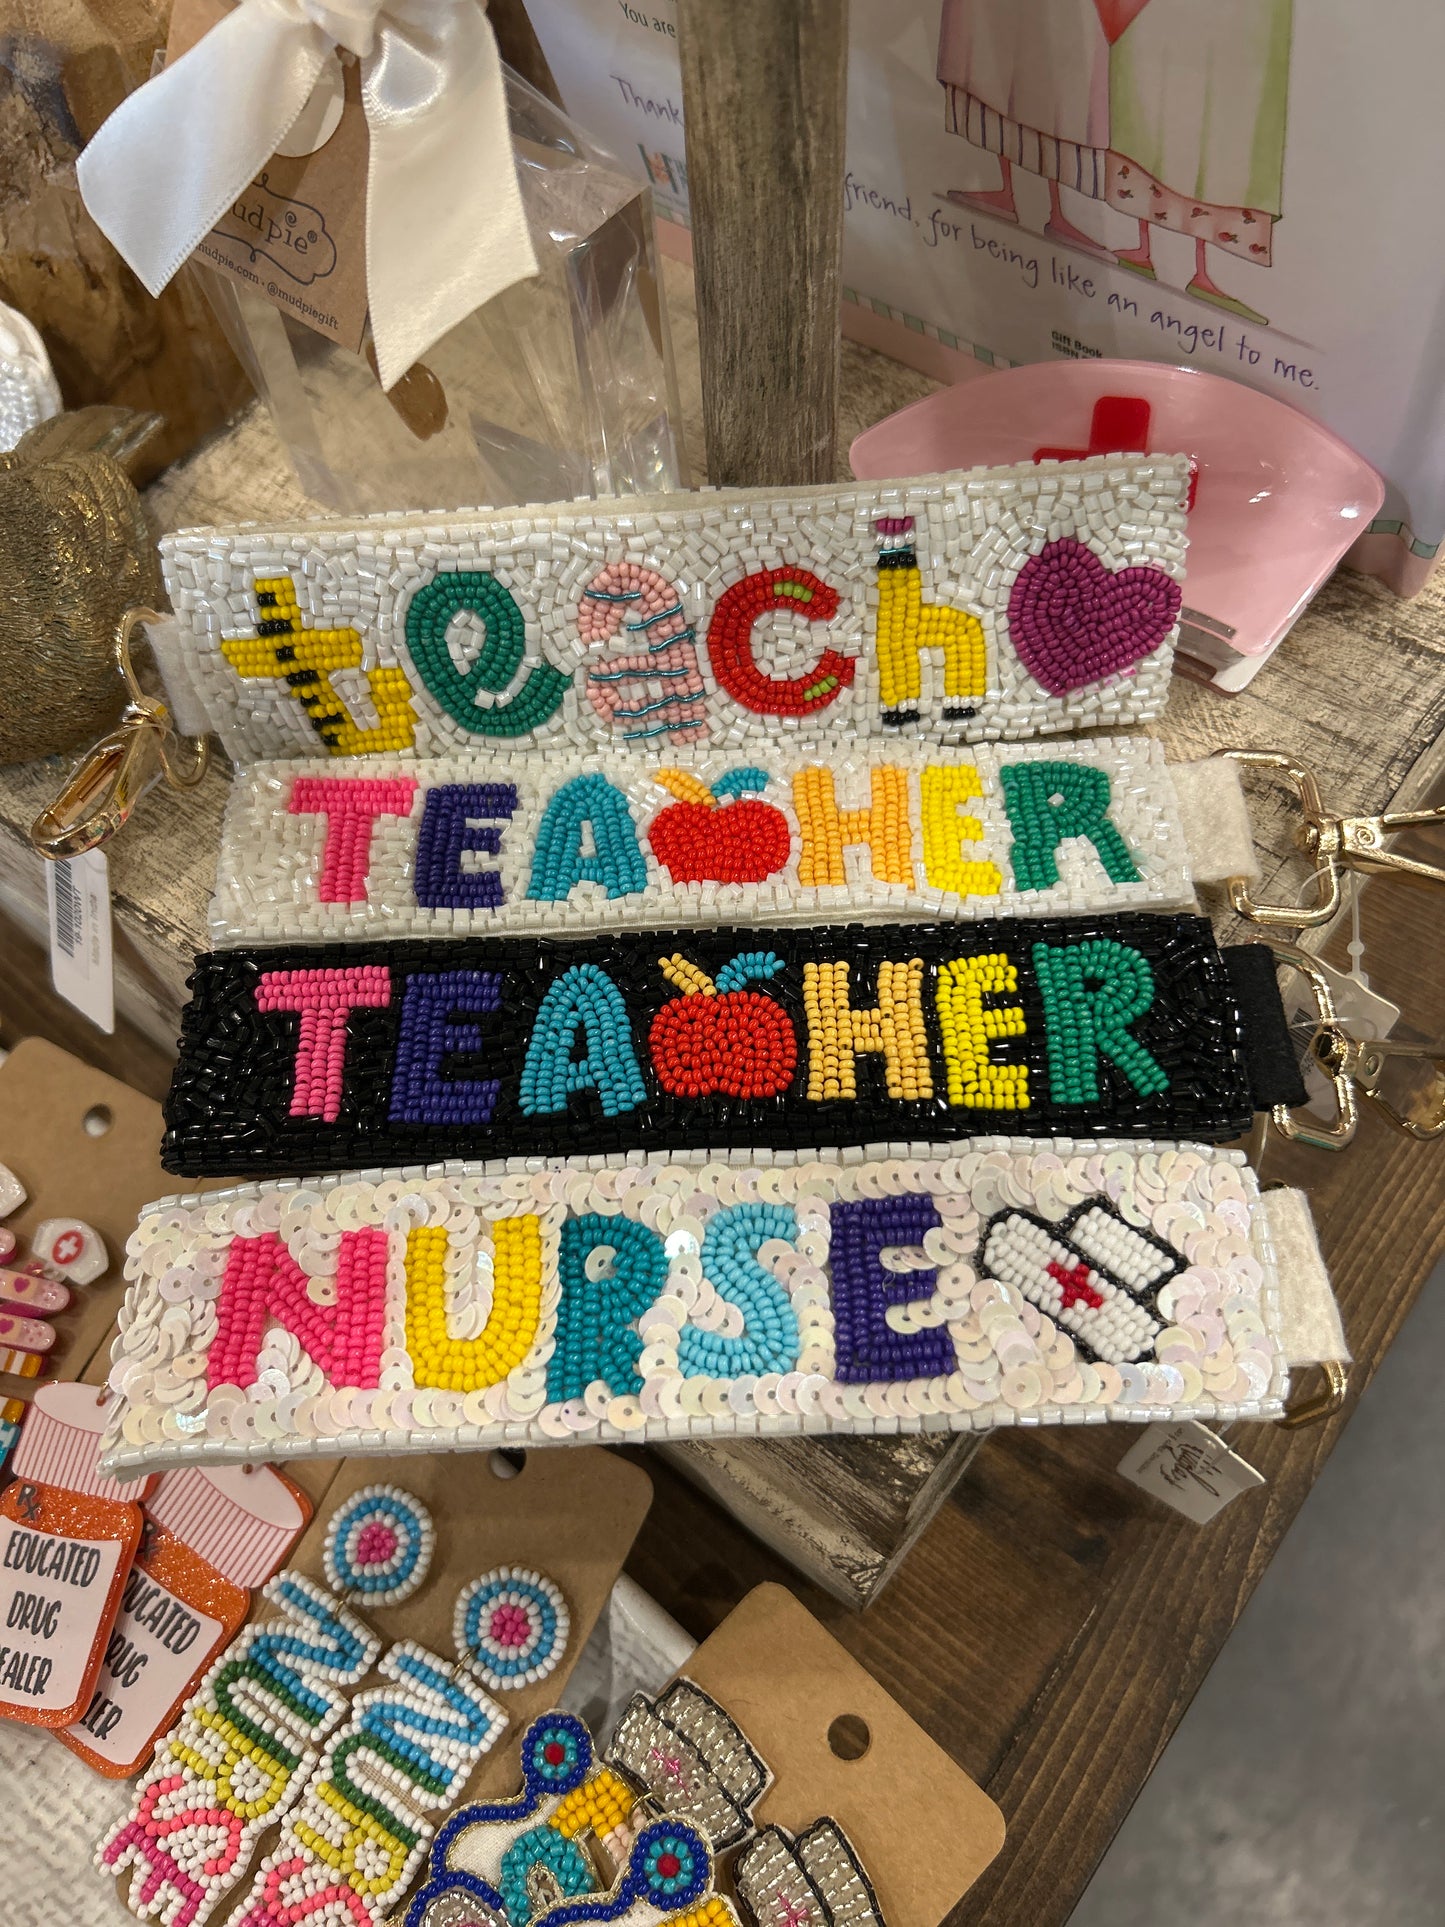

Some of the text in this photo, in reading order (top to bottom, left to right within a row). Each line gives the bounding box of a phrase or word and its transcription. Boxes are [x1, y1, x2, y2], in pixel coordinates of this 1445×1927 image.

[618, 0, 676, 38] You are
[609, 74, 1320, 390] Thank friend, for being like an angel to me.
[267, 281, 339, 330] @mudpiegift
[1051, 330, 1103, 359] Gift Book
[207, 1192, 956, 1401] NURSE
[4, 1530, 100, 1588] EDUCATED
[6, 1591, 61, 1640] DRUG
[123, 1567, 201, 1655] DUCATED
[104, 1630, 148, 1688] RUG
